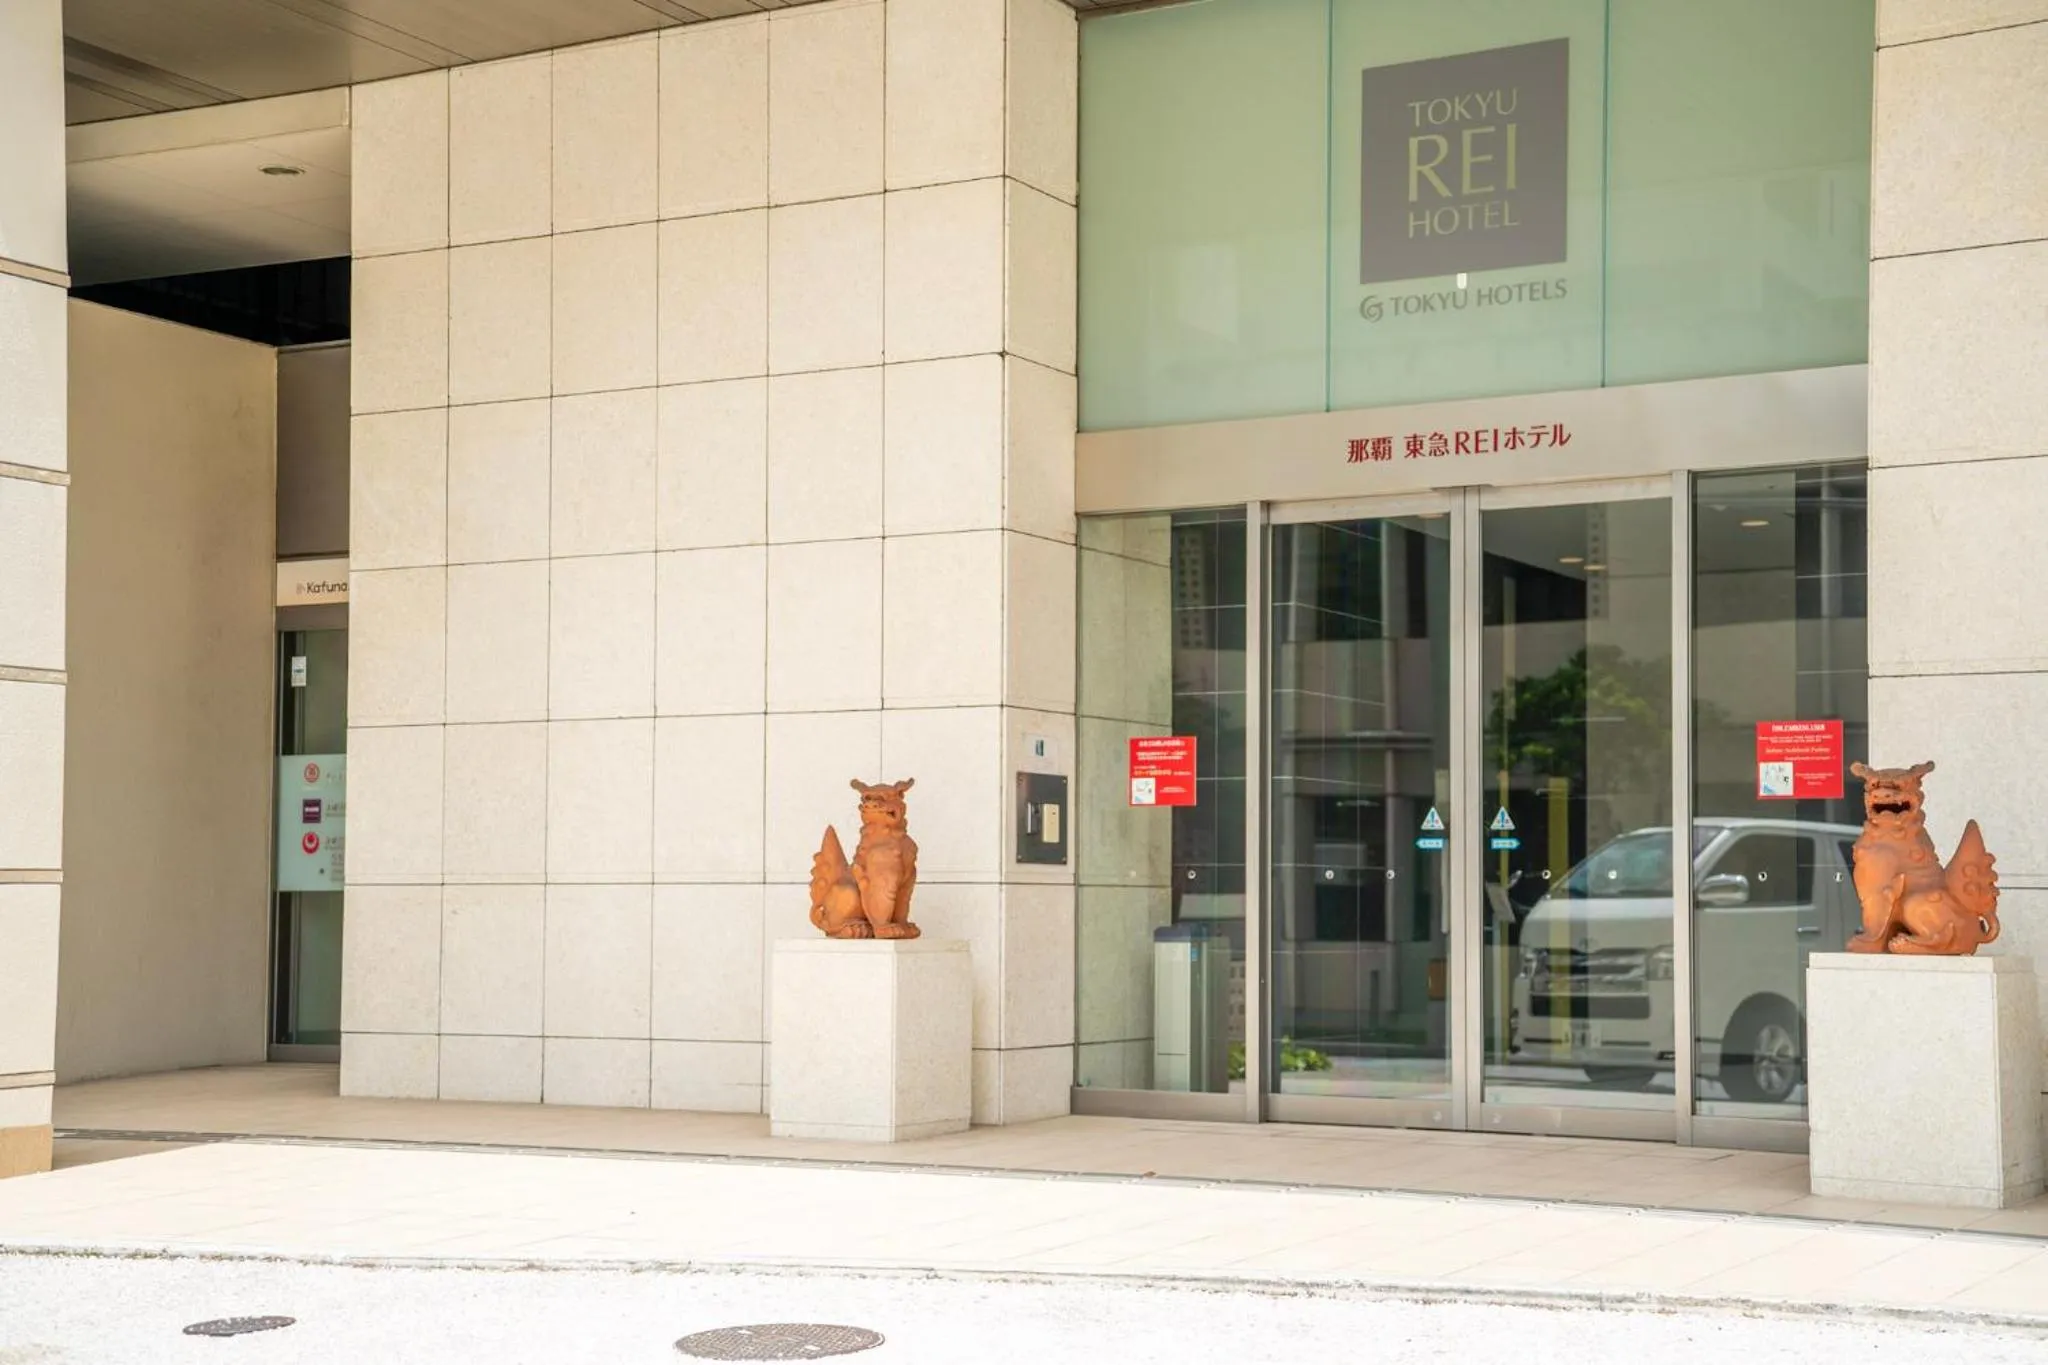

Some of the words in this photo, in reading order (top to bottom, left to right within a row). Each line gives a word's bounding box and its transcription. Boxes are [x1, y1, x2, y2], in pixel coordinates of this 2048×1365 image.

[1407, 88, 1517, 127] TOKYU
[1408, 124, 1517, 201] REI
[1408, 200, 1519, 238] HOTEL
[1391, 288, 1468, 317] TOKYU
[1476, 278, 1568, 306] HOTELS
[1347, 436, 1393, 463] 那覇
[1403, 423, 1572, 458] 東急REIホテル
